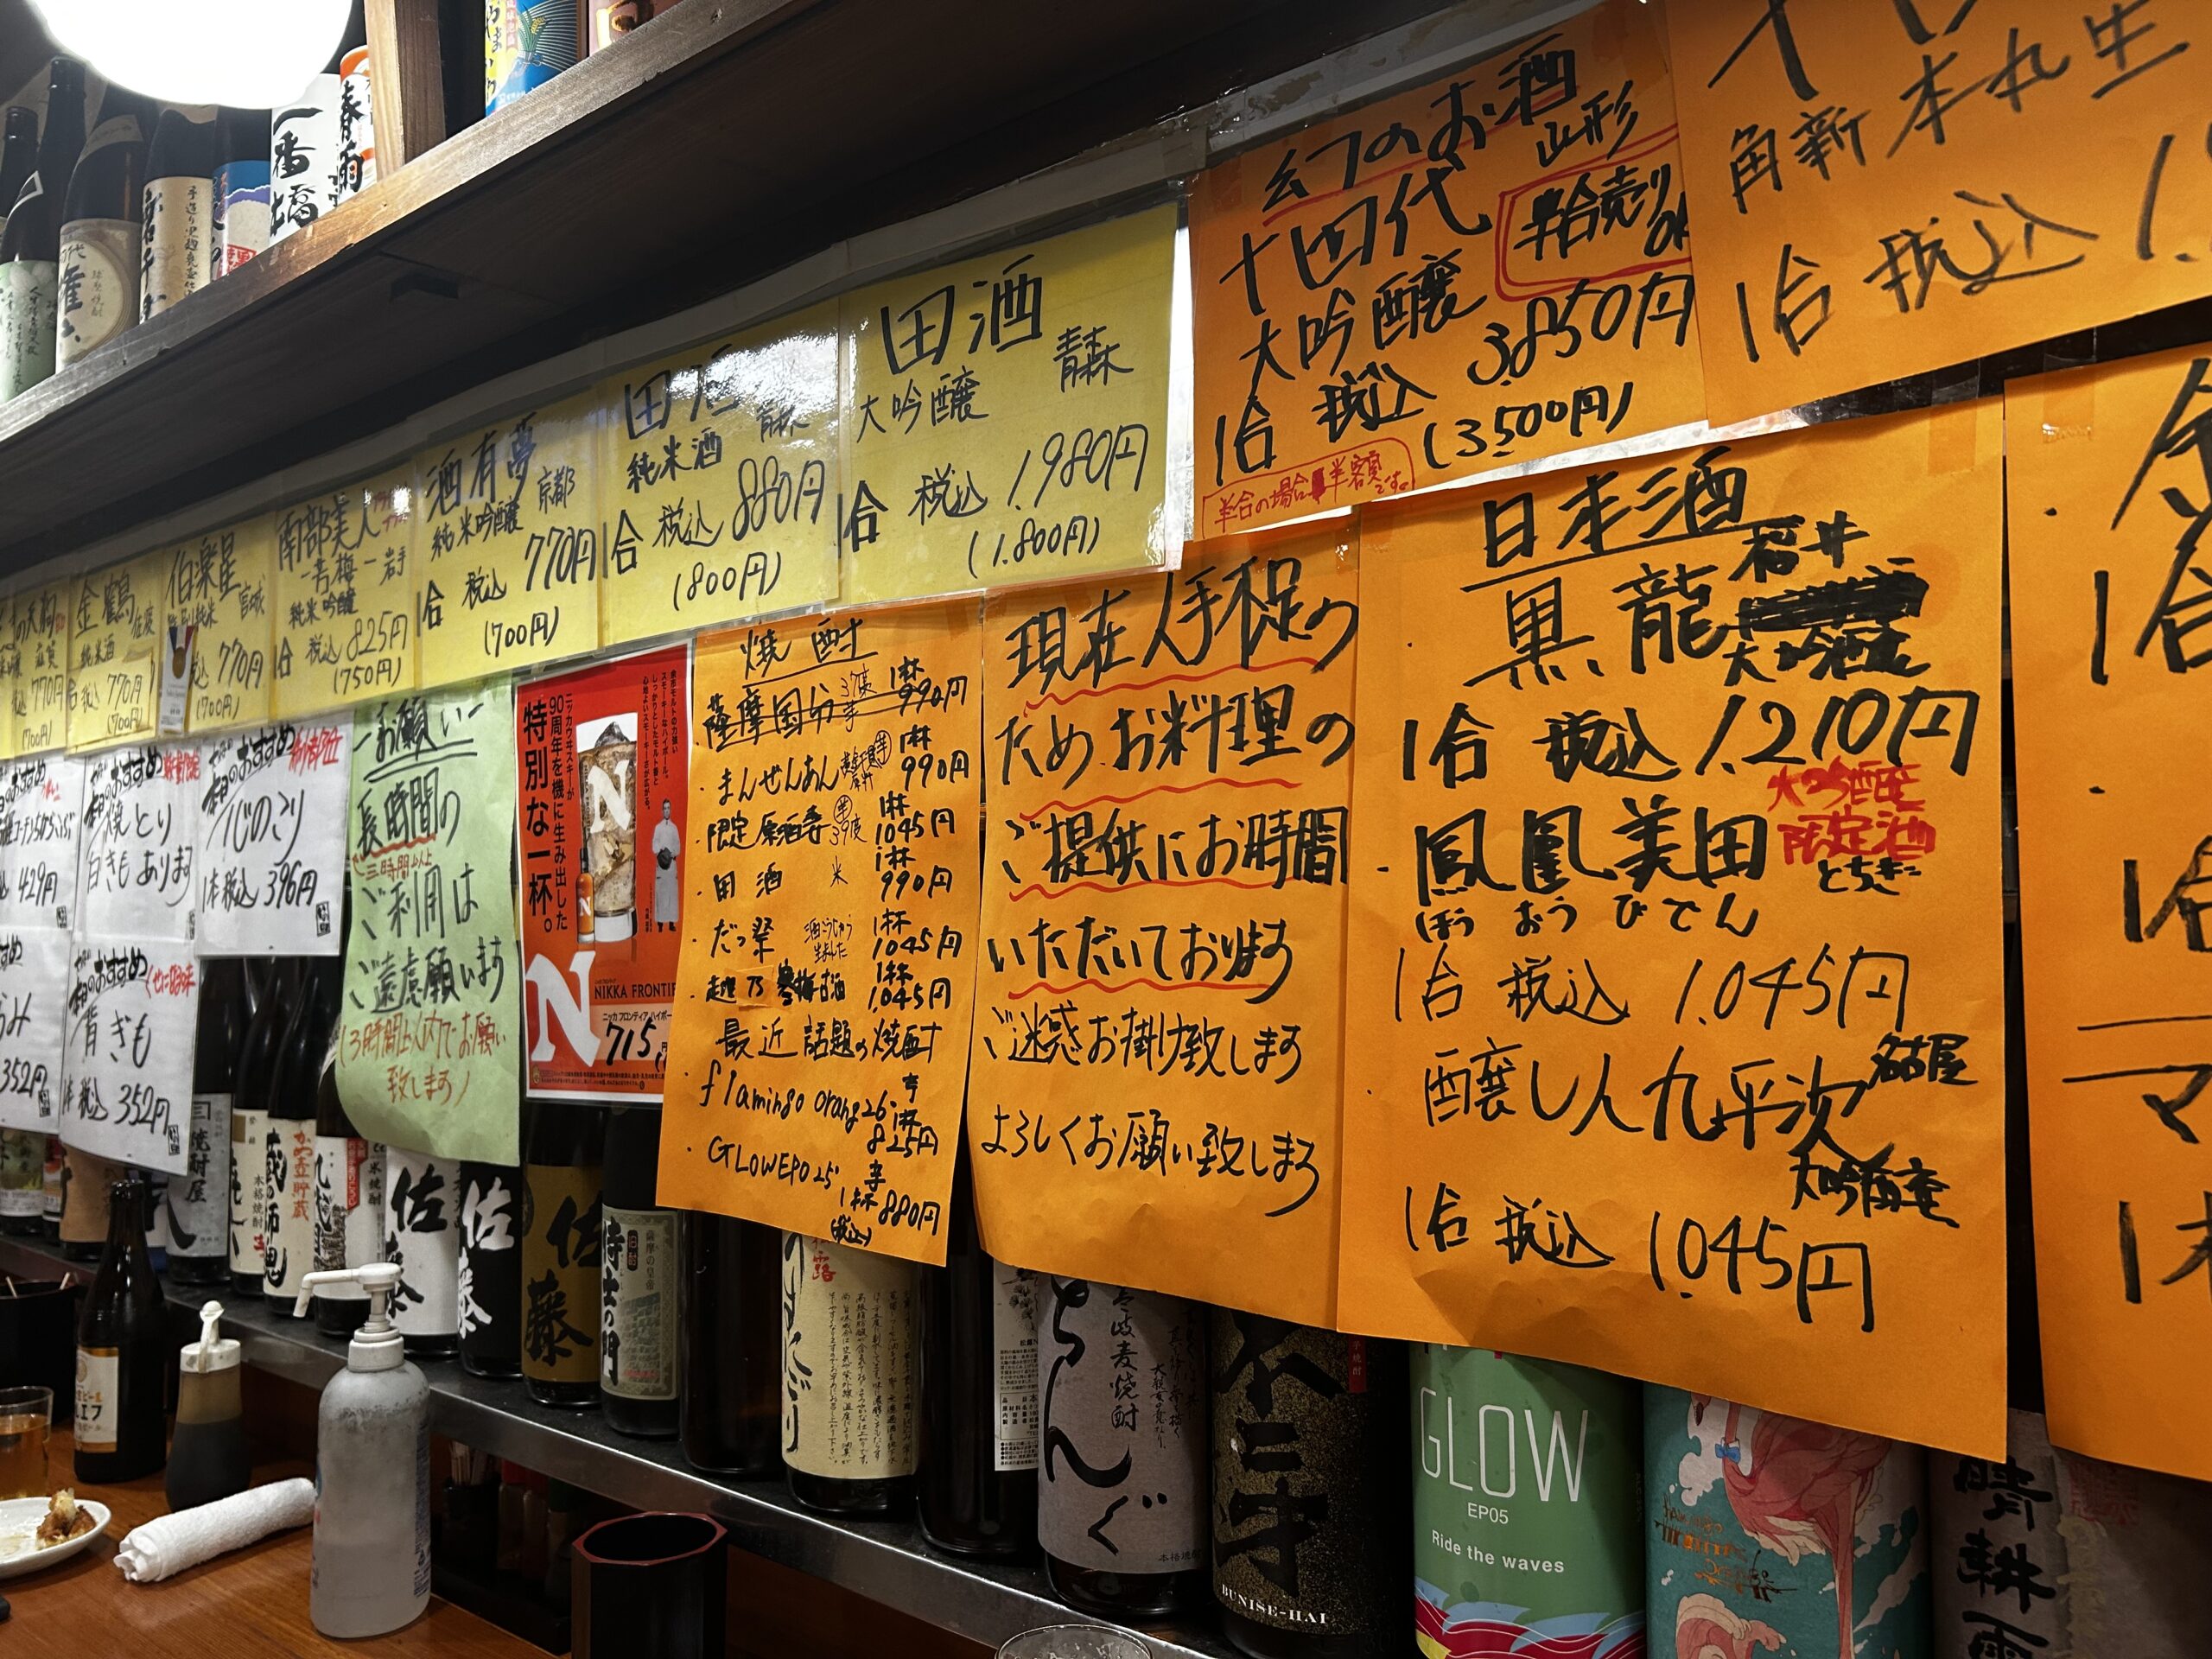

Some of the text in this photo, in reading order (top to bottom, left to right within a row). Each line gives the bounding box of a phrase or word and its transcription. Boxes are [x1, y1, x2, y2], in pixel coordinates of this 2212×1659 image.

[1262, 33, 1578, 213] 幻のお酒
[1536, 79, 1639, 168] 山形
[1219, 167, 1493, 316] 十四代
[1863, 190, 2100, 315] 税込
[880, 254, 1044, 375] 田酒
[1239, 249, 1488, 393] 大吟醸
[1052, 325, 1135, 393] 青森
[856, 365, 989, 442] 大吟醸
[1312, 361, 1438, 443] 税込
[537, 466, 576, 515] 京都
[626, 427, 722, 493] 純米酒
[909, 462, 988, 525] 税込
[277, 487, 381, 572] 南部美人
[430, 495, 525, 562] 純米吟醸
[652, 497, 724, 549] 税込
[733, 454, 826, 542] 880円
[1482, 445, 1750, 569] 日本酒
[164, 531, 243, 609] 伯楽星
[461, 566, 507, 610] 税込
[524, 525, 597, 592] 770円
[674, 551, 782, 611] (800円)
[289, 588, 359, 630] 純米吟醸
[346, 611, 409, 663] 825円
[484, 606, 560, 657] (700円)
[1004, 556, 1360, 696] 現在人手不足の
[1462, 562, 1733, 690] 黒龍
[218, 638, 264, 690] 770円
[305, 633, 343, 665] 税込
[334, 657, 403, 696] (750円)
[740, 618, 865, 681] 焼酎
[107, 672, 143, 710] 770円
[196, 694, 240, 721] (700円)
[899, 676, 969, 717] 990円
[564, 692, 575, 801] ニッカウヰスキーが
[901, 749, 969, 792] 990円
[1402, 701, 1496, 790] 1合
[1531, 706, 1682, 786] 税込
[105, 799, 172, 847] 焼とり
[356, 766, 461, 859] 長時間の
[523, 699, 554, 933] 特別な一杯。
[550, 694, 569, 931] 90周年を機に生み出した
[588, 760, 632, 834] N
[875, 808, 955, 846] 1045円
[830, 855, 849, 888] 米
[1001, 805, 1351, 890] ご提供にお時間
[1414, 791, 1769, 907] 鳳凰美田
[1817, 855, 1923, 897] とちぎ
[18, 861, 58, 907] 429円
[264, 861, 318, 909] 396円
[361, 862, 479, 940] ご利用は
[880, 865, 953, 902] 990円
[350, 934, 505, 1015] ご遠慮願います
[872, 925, 963, 961] 1045円
[987, 914, 1294, 1005] いただいております
[525, 950, 601, 1068] N
[594, 984, 628, 1001] NIKKA
[602, 1011, 619, 1022] ニッカ
[619, 1010, 650, 1022] フロンティア
[1393, 943, 1463, 1023] 1合
[1497, 955, 1631, 1026] 税込
[606, 1016, 658, 1066] 715
[982, 999, 1303, 1085] ご迷惑お掛け致します
[114, 1083, 171, 1136] 352円
[699, 1058, 805, 1122] flamingo
[1423, 1036, 1896, 1166] 醸し人九平次
[866, 1122, 939, 1159] 825円
[981, 1103, 1320, 1217] よろしくお願い致します
[368, 1160, 383, 1206] 米焼酎
[877, 1189, 941, 1236] 880円
[1493, 1196, 1616, 1268] 税込
[524, 1191, 603, 1368] 佐藤
[1420, 1386, 1589, 1503] GLOW
[1467, 1502, 1510, 1524] EP05
[1431, 1529, 1565, 1573] Ride the waves
[1221, 1583, 1328, 1625] BUNISE-HAI
